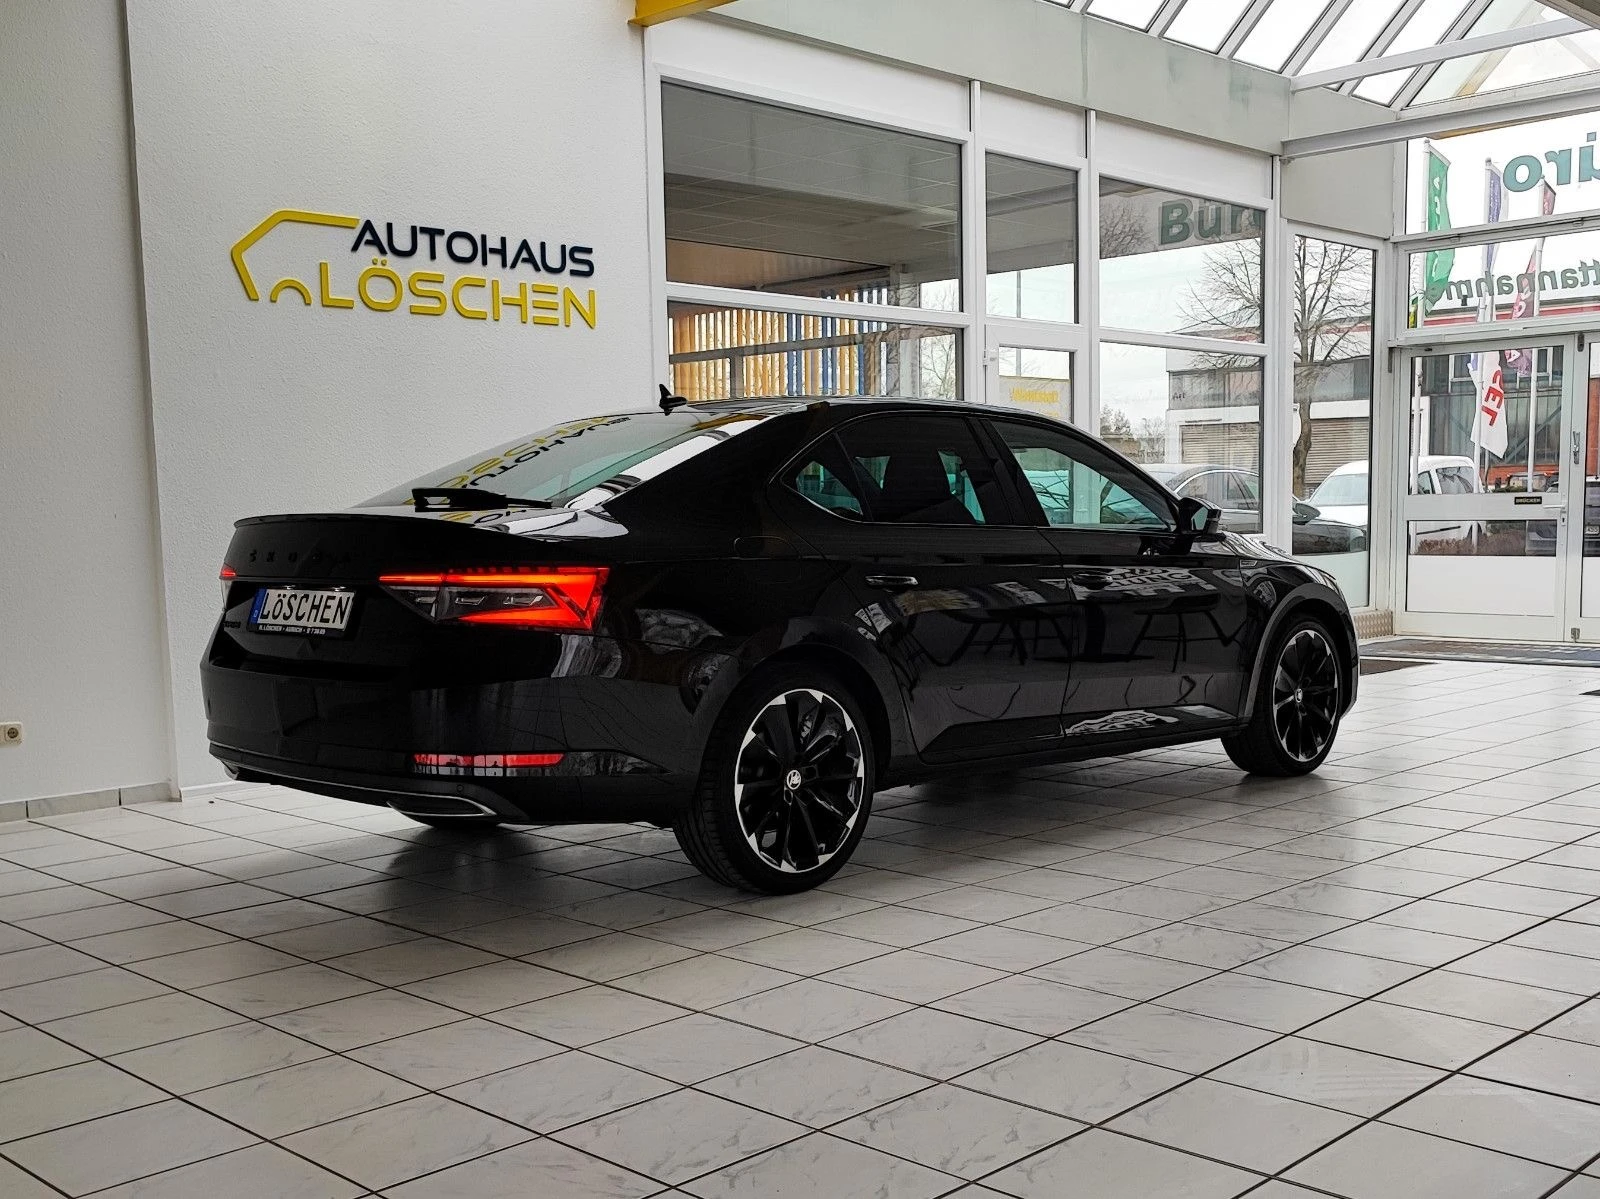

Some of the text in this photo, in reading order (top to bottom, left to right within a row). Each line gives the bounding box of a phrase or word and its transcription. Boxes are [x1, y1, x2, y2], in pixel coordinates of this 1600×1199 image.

[351, 219, 595, 277] AUTOHAUS
[319, 258, 596, 330] LÖSCHEN
[260, 592, 351, 625] LÖSCHEN
